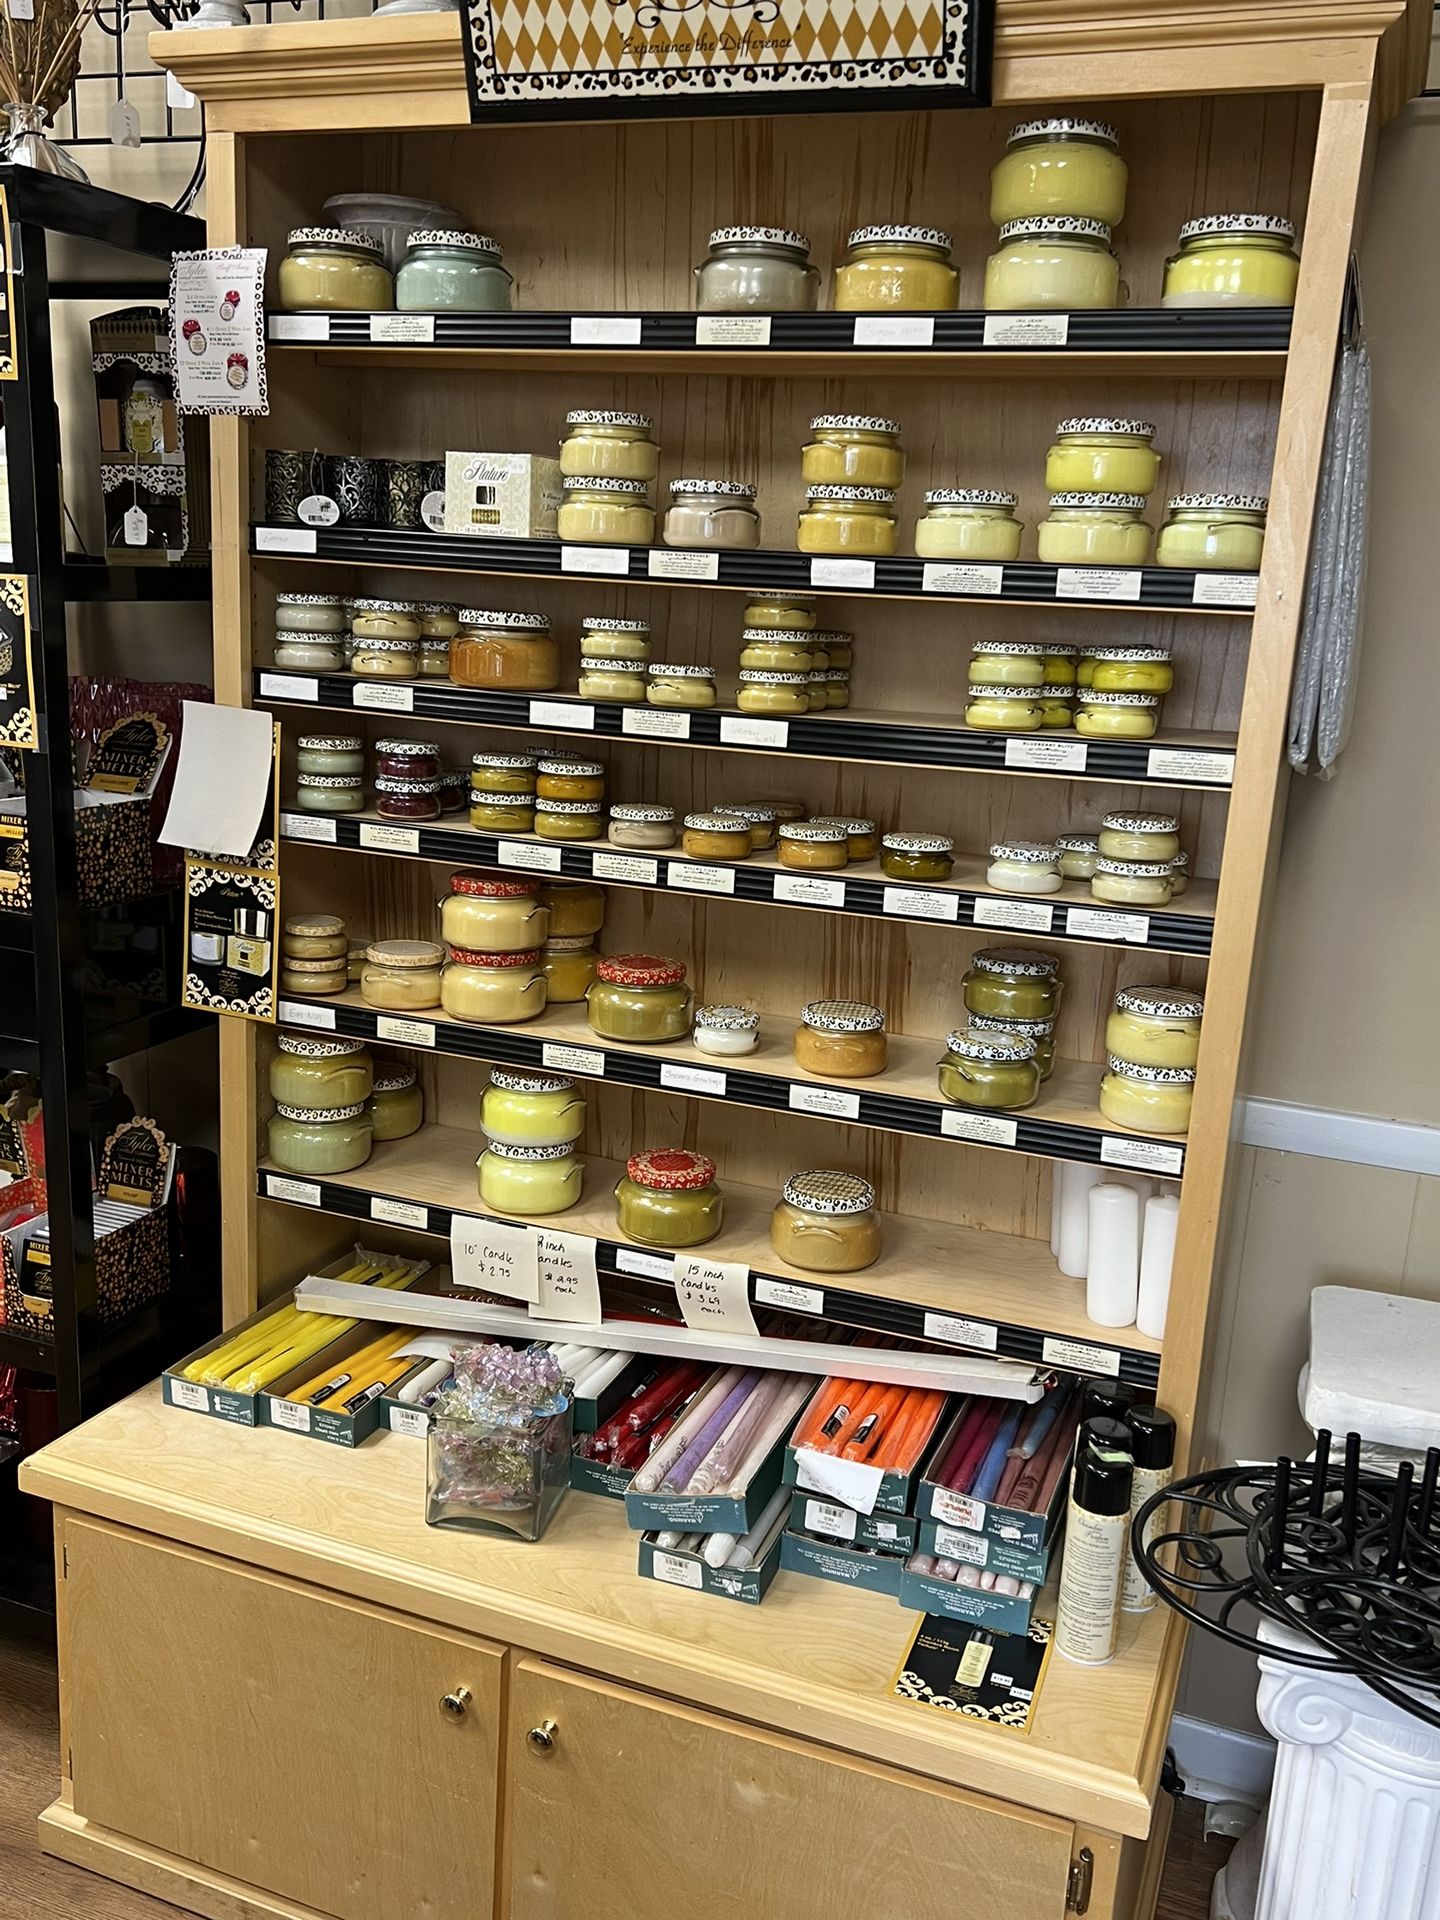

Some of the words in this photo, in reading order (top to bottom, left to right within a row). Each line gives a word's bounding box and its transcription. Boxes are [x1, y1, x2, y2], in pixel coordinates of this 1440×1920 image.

[694, 32, 715, 52] the
[104, 751, 147, 765] MIXER
[99, 761, 143, 775] MELTS
[0, 815, 23, 825] MIXER
[113, 1160, 154, 1178] MIXER
[112, 1171, 152, 1188] MELTS
[29, 1241, 50, 1253] MIXER
[545, 1239, 566, 1254] inch
[483, 1245, 514, 1265] Candle
[537, 1255, 573, 1269] andles
[687, 1263, 701, 1276] 15
[703, 1270, 725, 1281] inch
[554, 1285, 576, 1295] each
[700, 1306, 725, 1316] each
[819, 1567, 851, 1579] WARNING:
[942, 1603, 976, 1616] WARNING:
